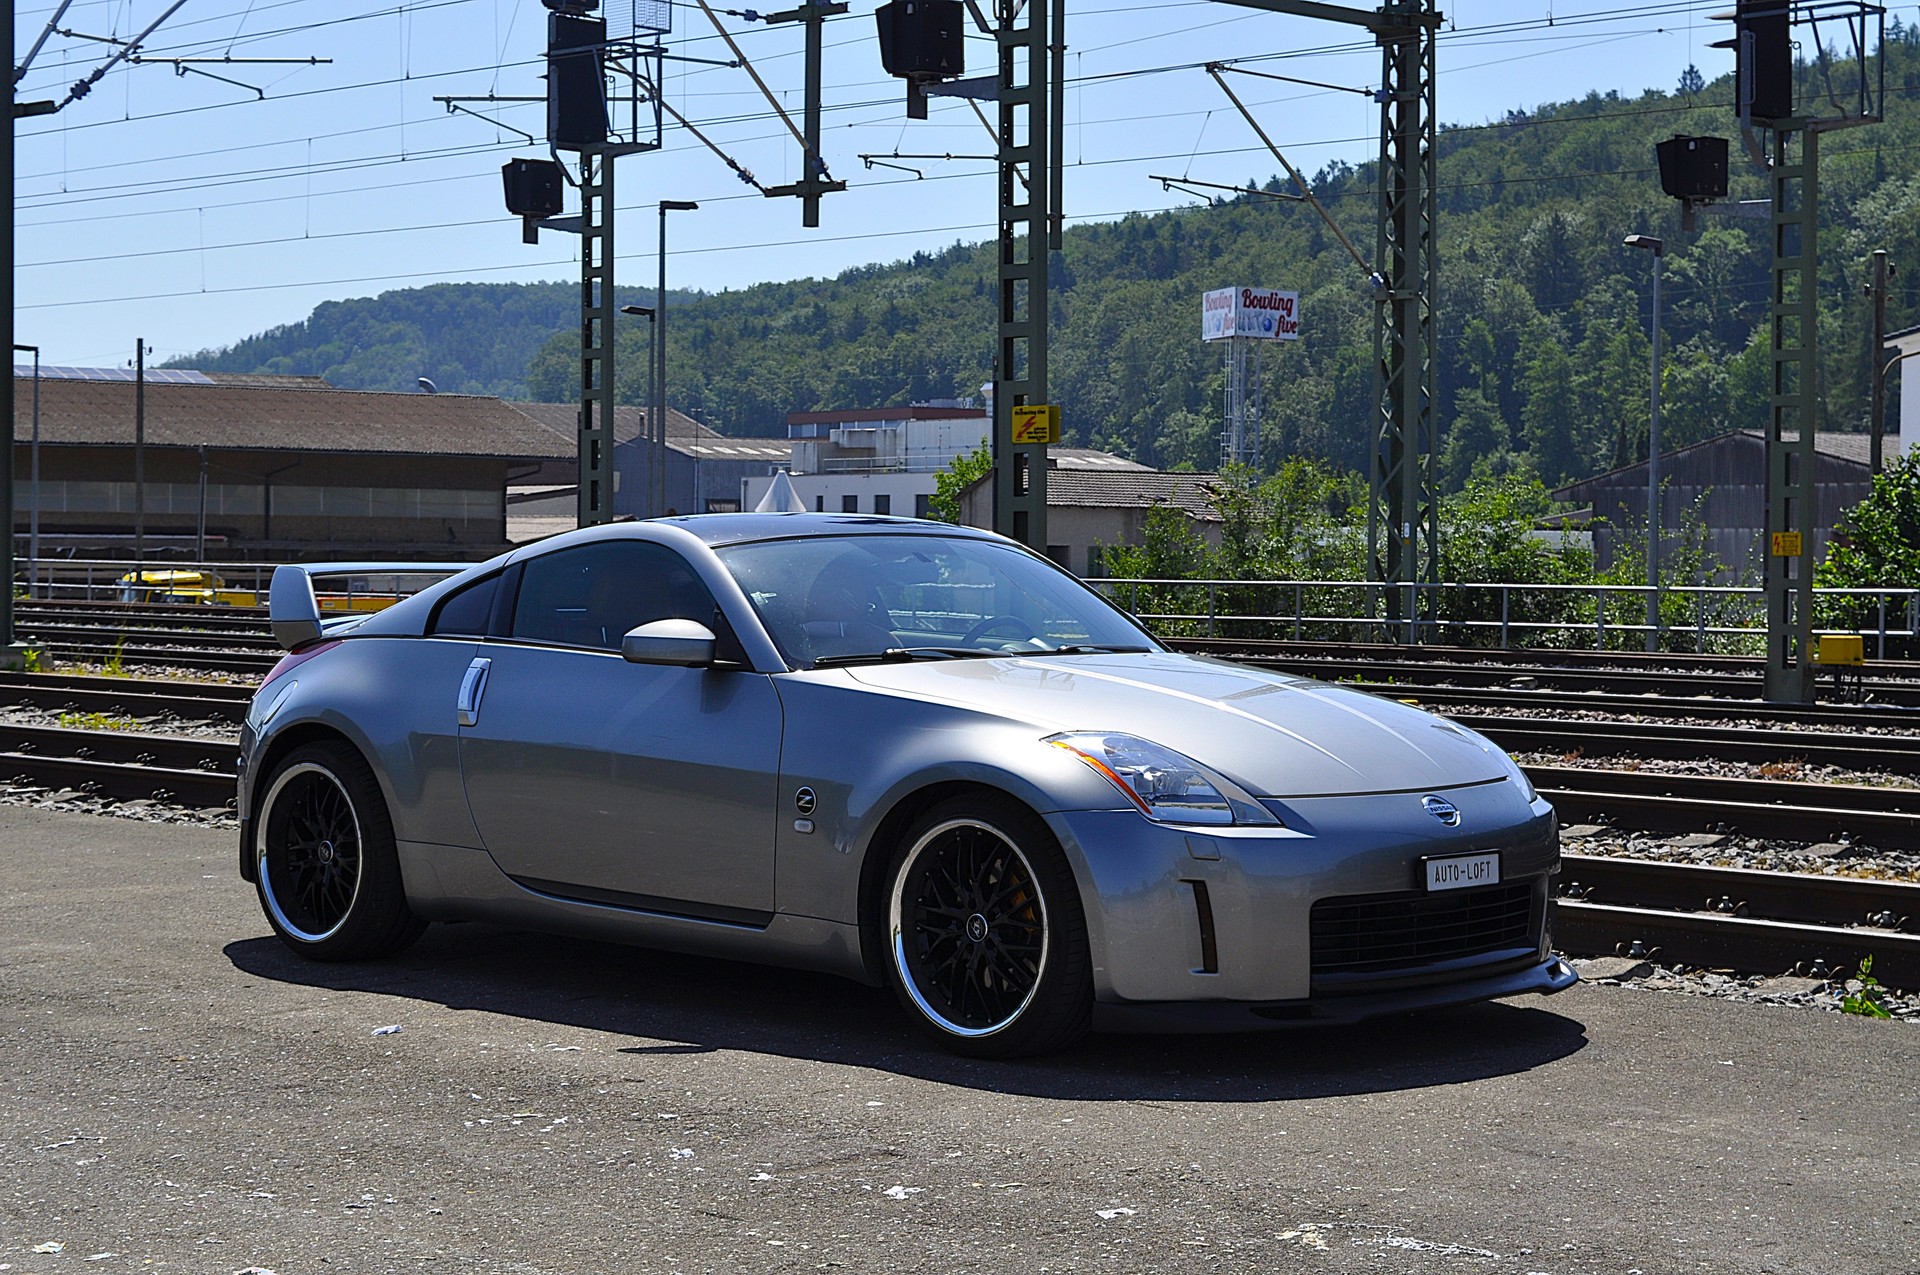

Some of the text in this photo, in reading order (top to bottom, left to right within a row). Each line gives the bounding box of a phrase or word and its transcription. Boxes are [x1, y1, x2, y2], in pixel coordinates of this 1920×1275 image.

[1205, 291, 1233, 313] Bowling
[1241, 288, 1294, 317] Bowling
[1274, 314, 1297, 337] five
[797, 794, 812, 807] Z
[1435, 862, 1491, 884] AUTO-LOFT
